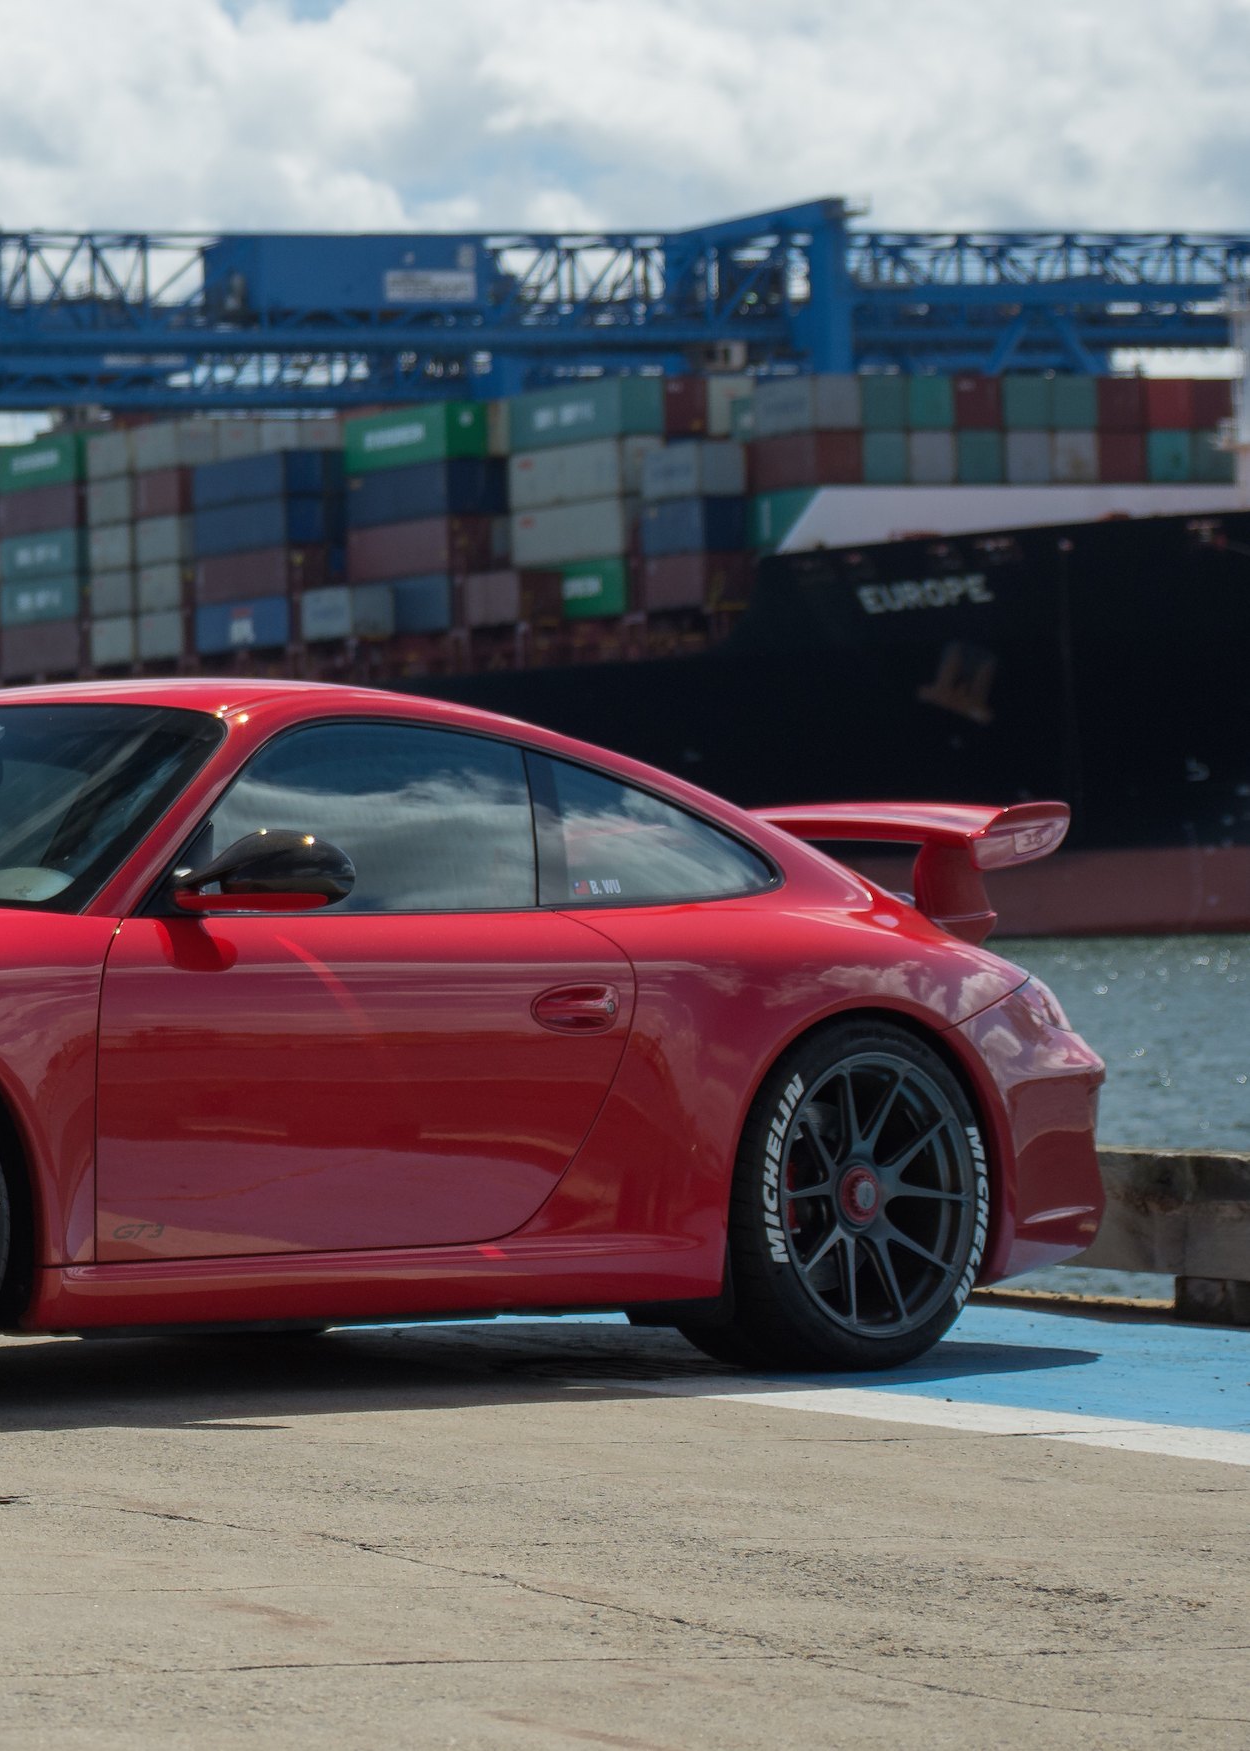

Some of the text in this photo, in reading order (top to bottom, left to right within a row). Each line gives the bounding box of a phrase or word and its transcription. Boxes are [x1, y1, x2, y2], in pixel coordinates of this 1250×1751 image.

[857, 574, 994, 615] EUROPE
[590, 879, 621, 895] B. WU
[763, 1073, 805, 1264] MICHELIN
[113, 1223, 165, 1240] GT3
[953, 1126, 990, 1311] MICHELIN
